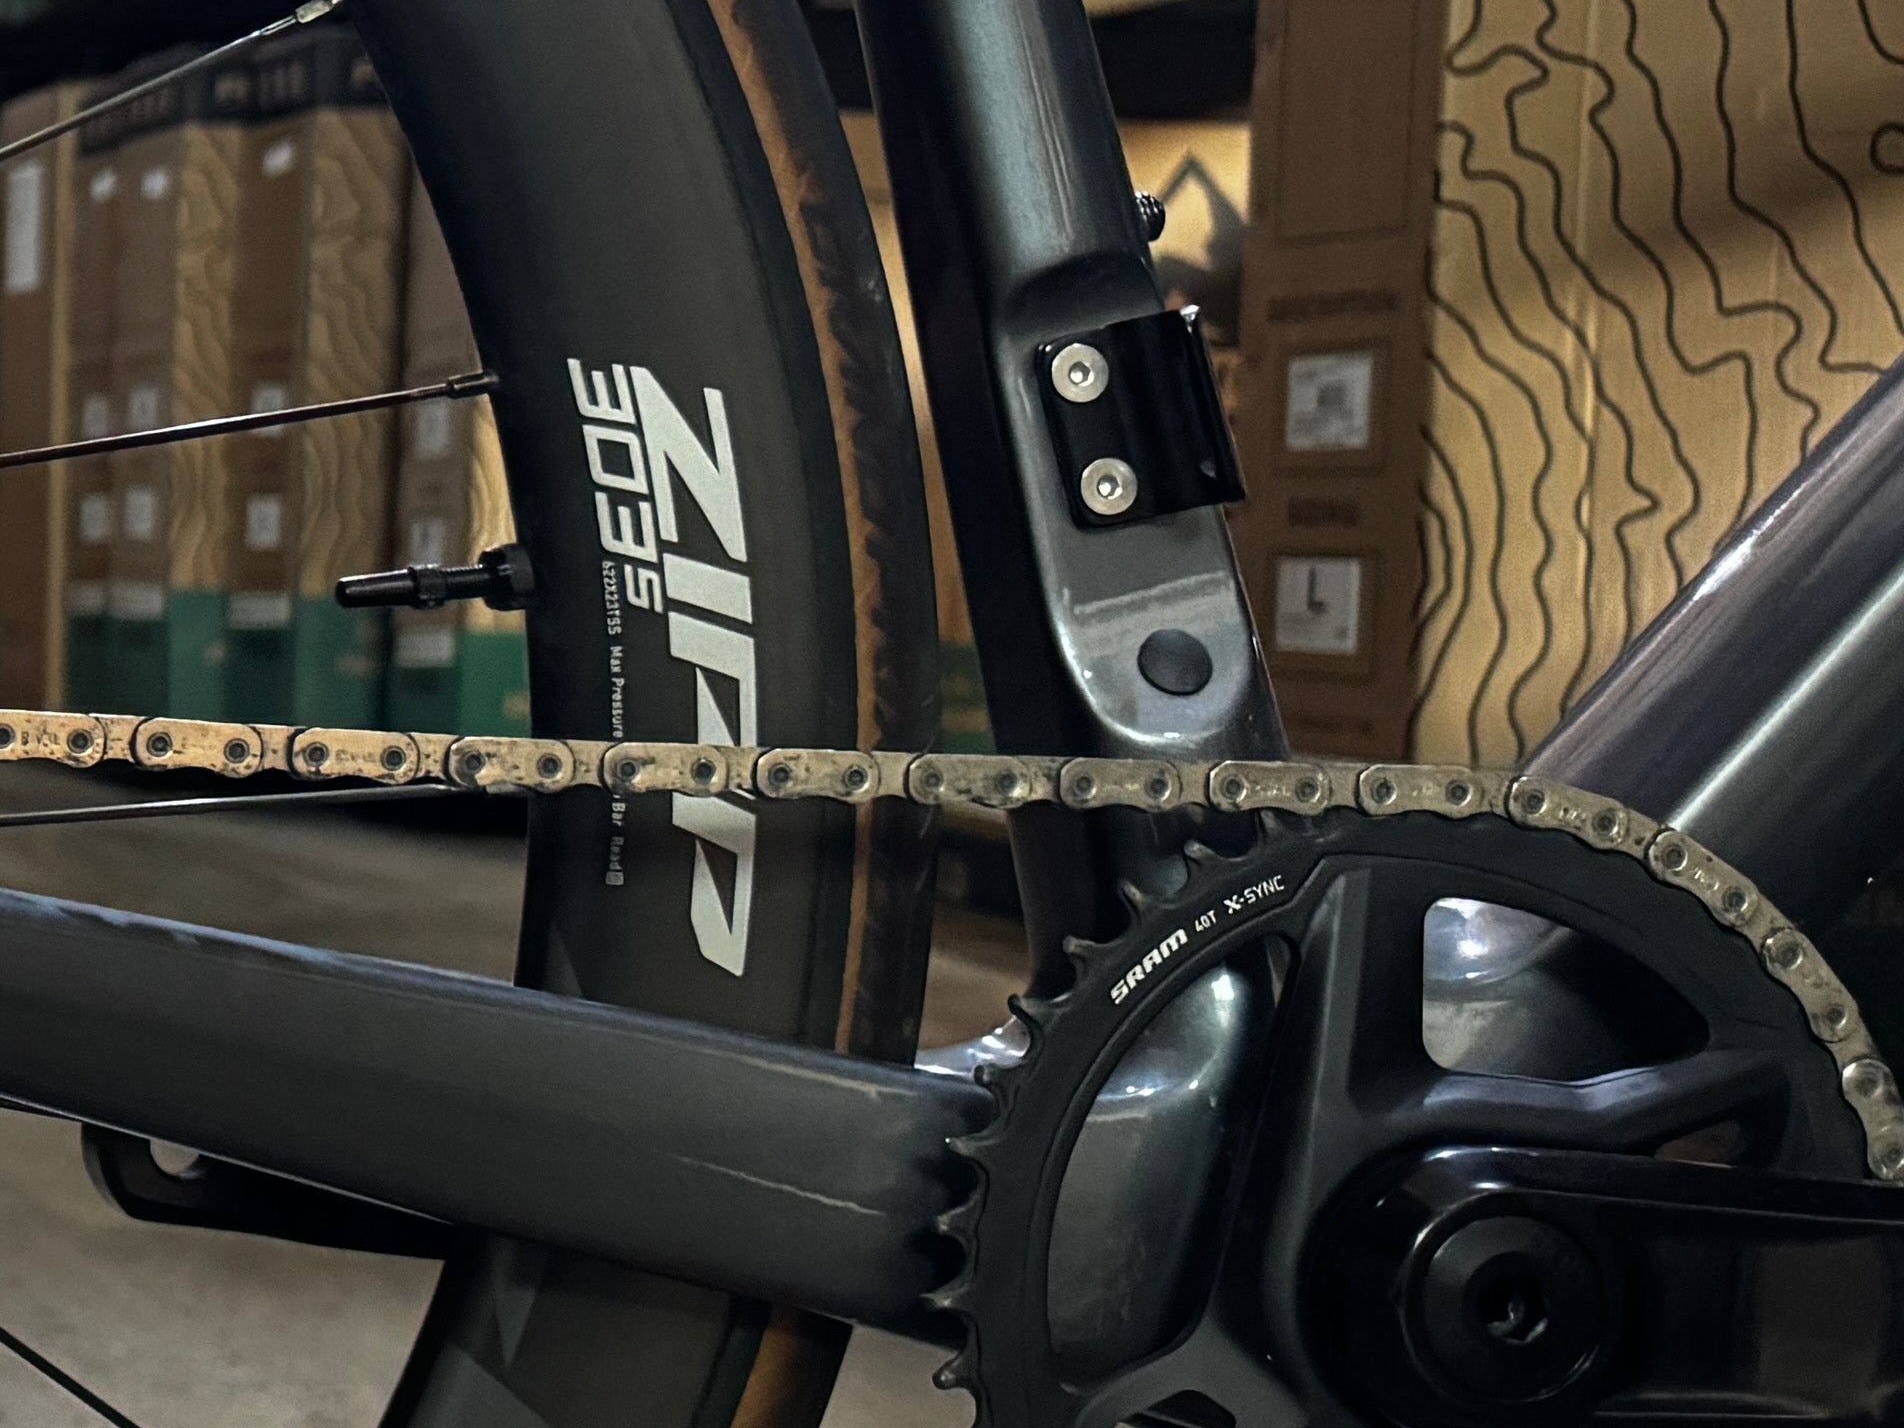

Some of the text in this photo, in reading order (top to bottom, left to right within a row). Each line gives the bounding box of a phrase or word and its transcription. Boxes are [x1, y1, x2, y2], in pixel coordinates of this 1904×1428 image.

[609, 645, 624, 673] Max
[610, 677, 626, 739] Pressure
[610, 802, 626, 827] Bar
[1109, 874, 1285, 1005] SRAM 40T X-SYNC
